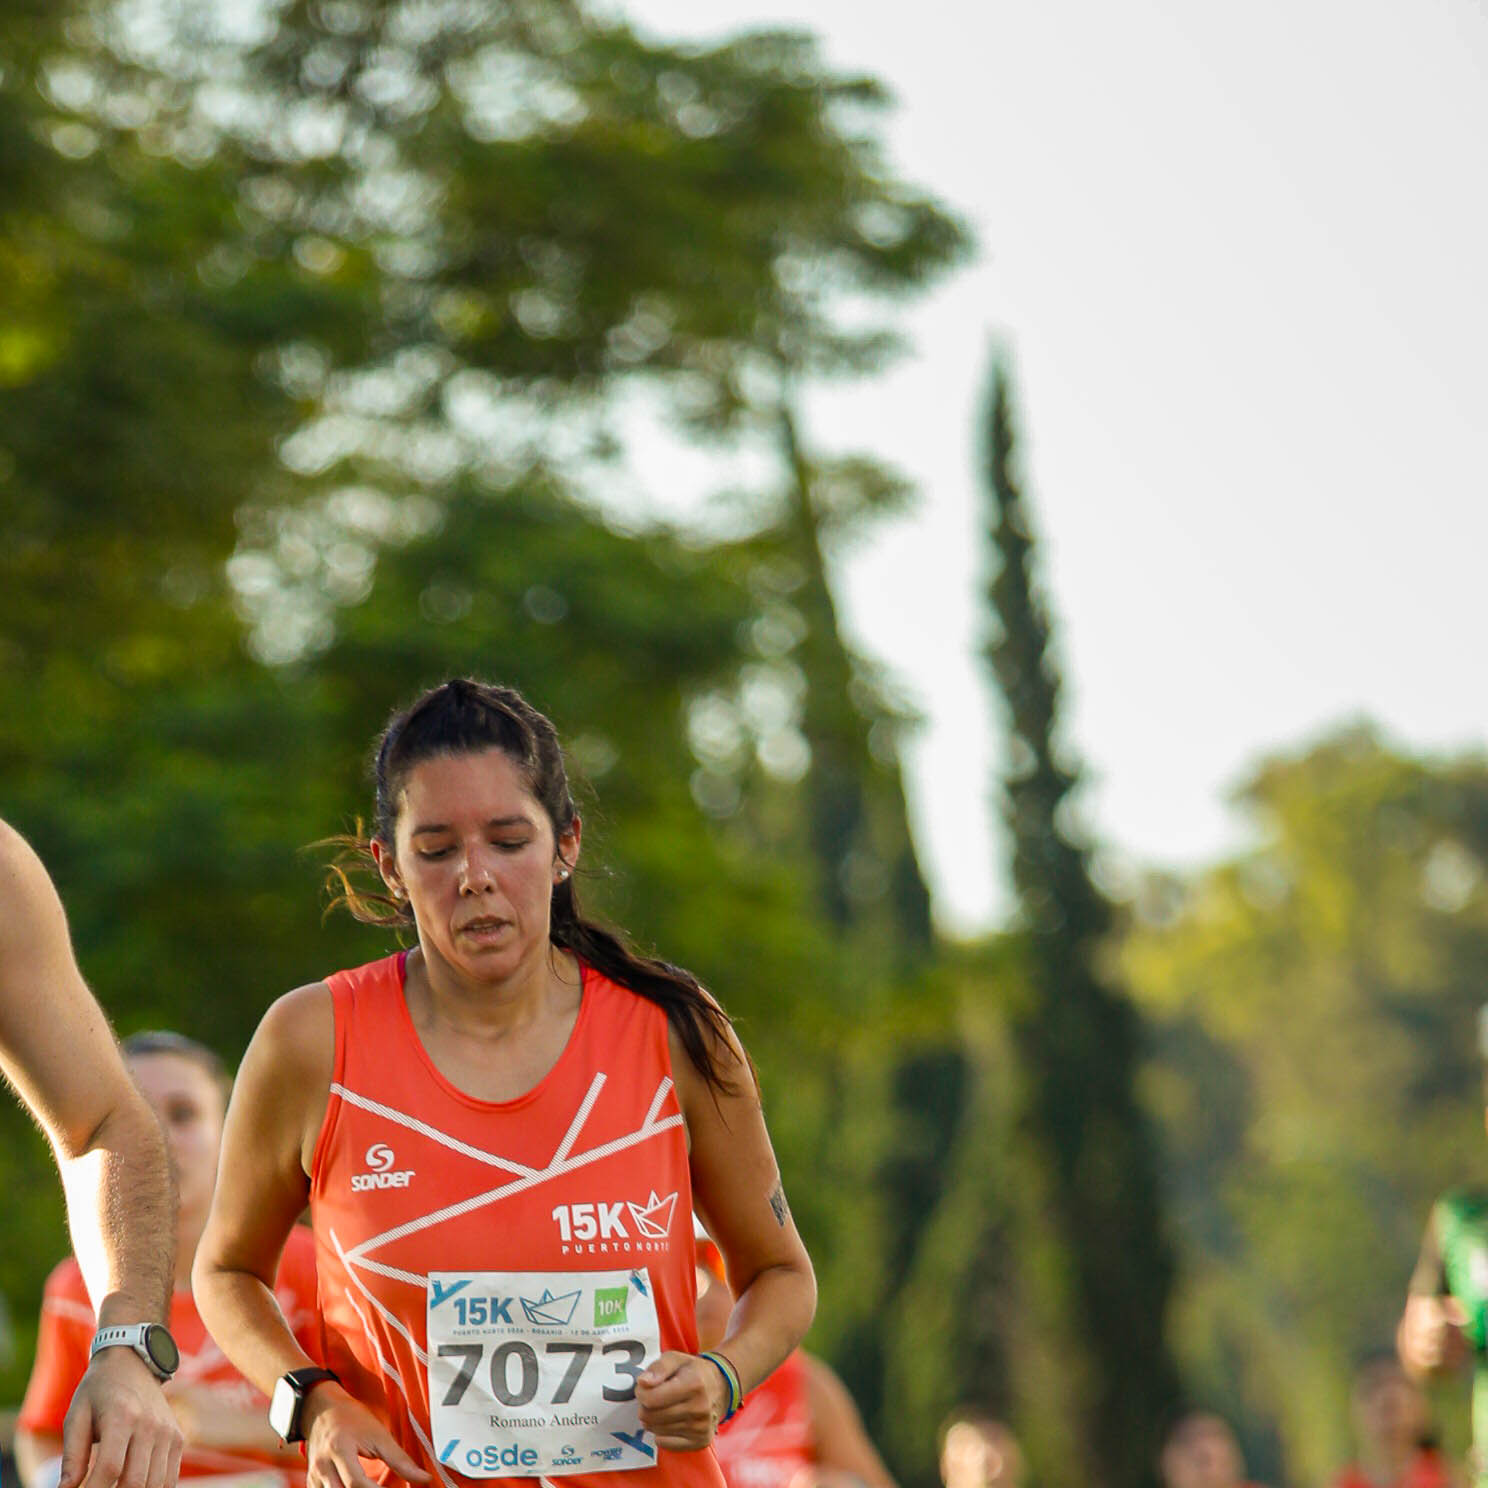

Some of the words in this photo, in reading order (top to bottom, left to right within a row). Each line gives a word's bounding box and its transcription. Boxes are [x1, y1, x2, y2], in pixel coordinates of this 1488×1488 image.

[552, 1202, 629, 1241] 15K
[562, 1241, 632, 1255] PUERTO
[453, 1297, 514, 1326] 15K
[598, 1300, 623, 1315] 10K
[438, 1339, 647, 1407] 7073
[489, 1414, 546, 1428] Romano
[550, 1412, 599, 1427] Andrea
[466, 1444, 538, 1471] osde
